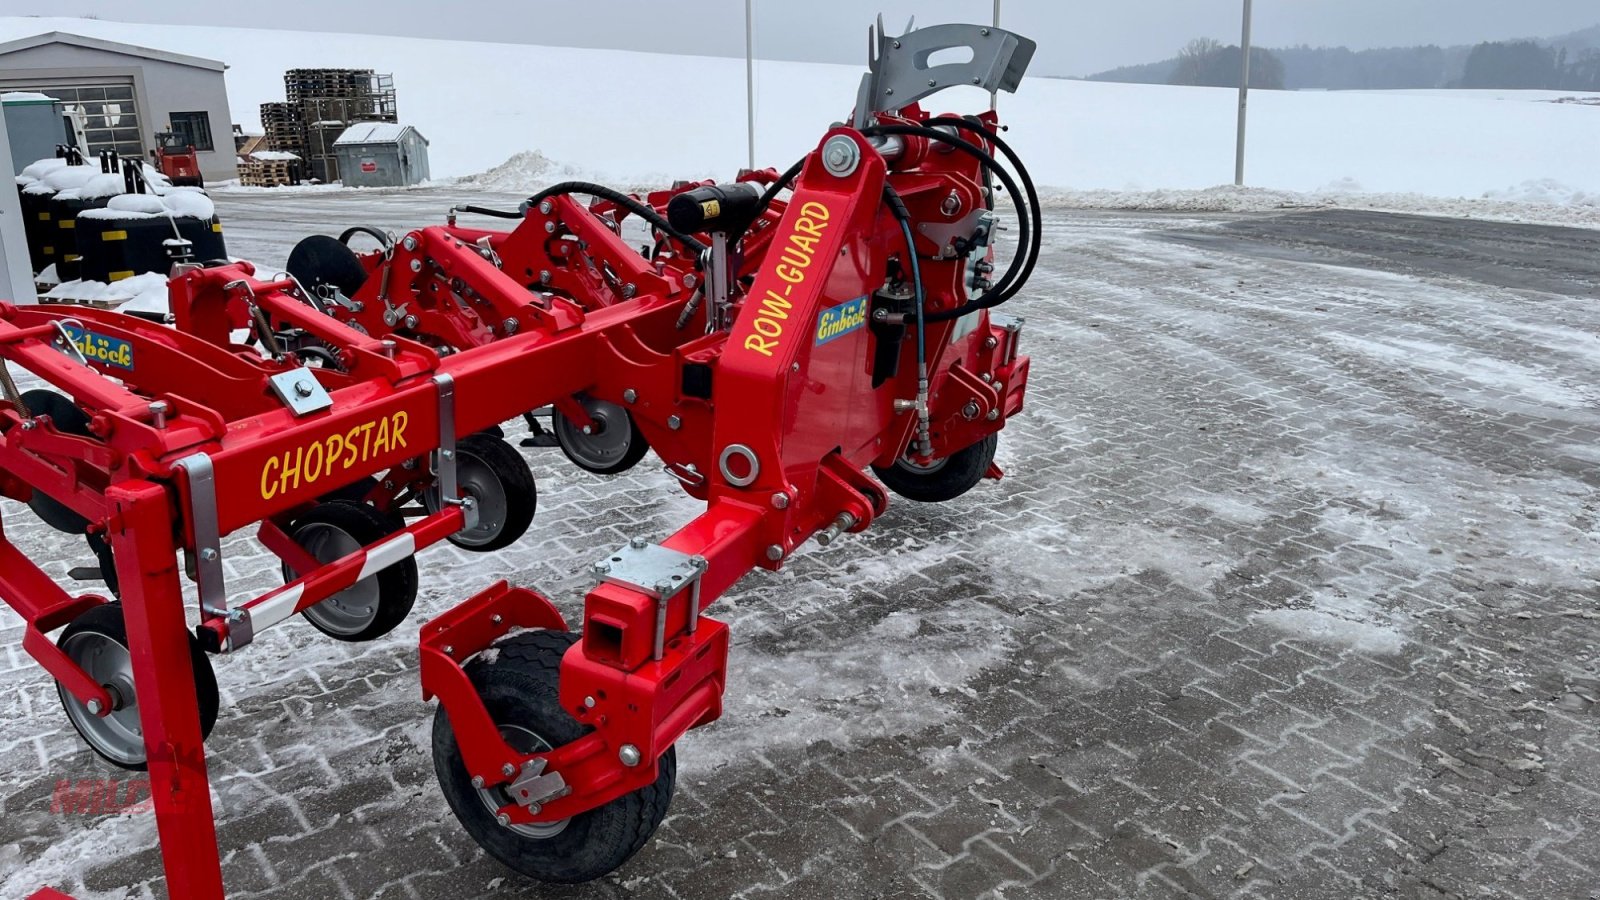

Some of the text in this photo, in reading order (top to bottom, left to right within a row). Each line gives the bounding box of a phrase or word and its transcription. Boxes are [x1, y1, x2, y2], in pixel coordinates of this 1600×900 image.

[744, 201, 831, 357] ROW-GUARD
[817, 299, 867, 340] Einböck
[260, 410, 409, 500] CHOPSTAR
